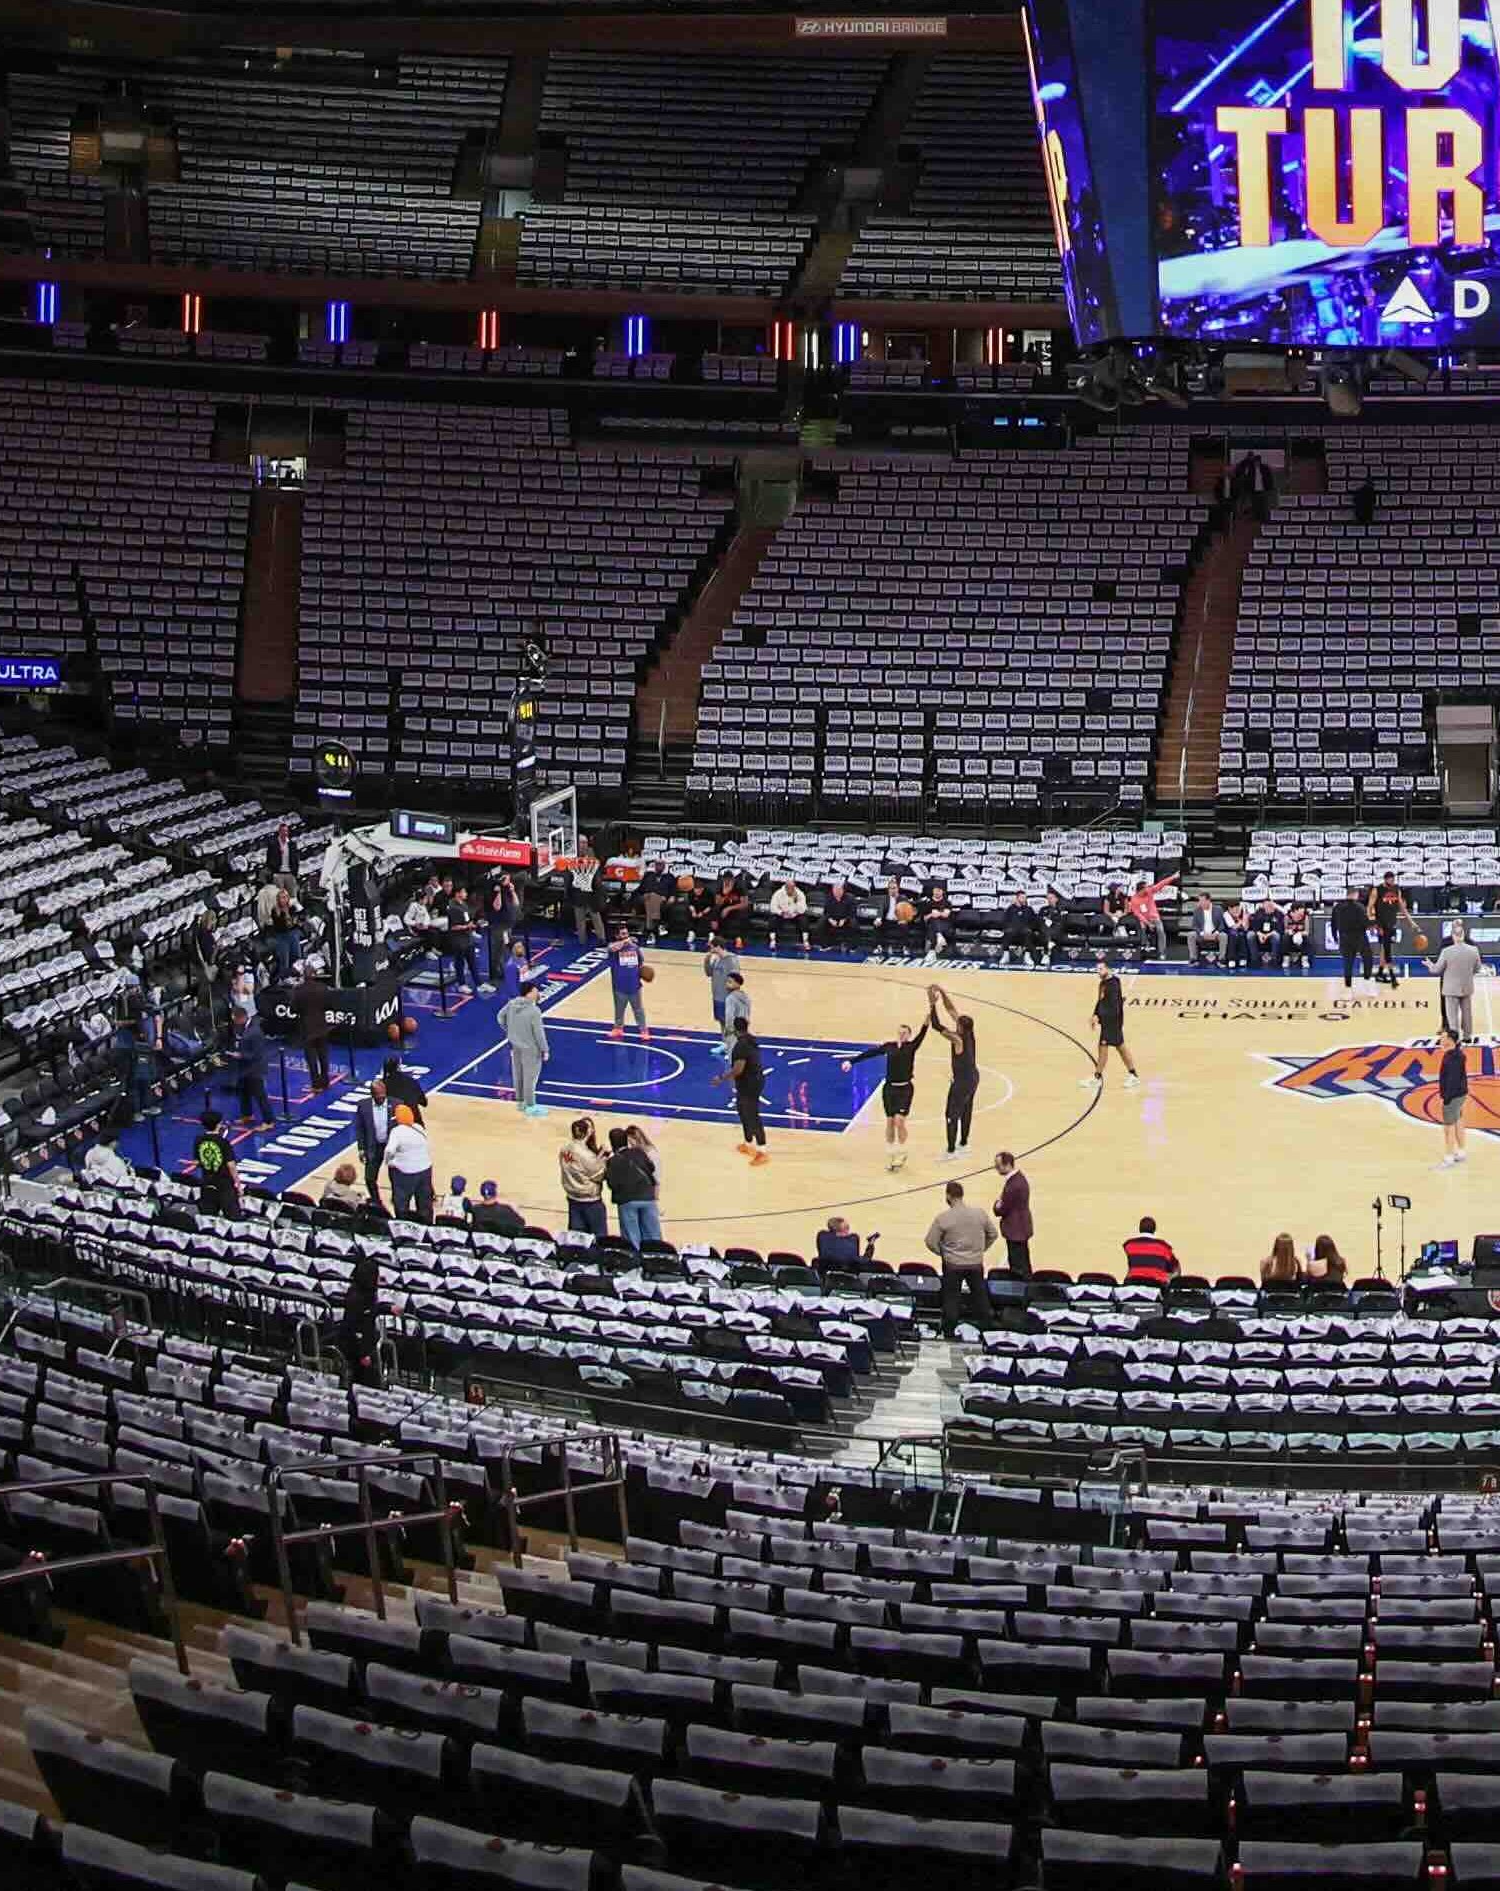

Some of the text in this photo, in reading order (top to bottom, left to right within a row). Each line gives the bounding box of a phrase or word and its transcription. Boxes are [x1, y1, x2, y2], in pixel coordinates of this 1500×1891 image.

[824, 21, 947, 33] HYUNDAI BRIDGE
[1122, 997, 1430, 1010] ADISON SQUARE GARDEN
[1176, 1011, 1309, 1021] CHASE
[235, 1114, 352, 1184] EW YORK
